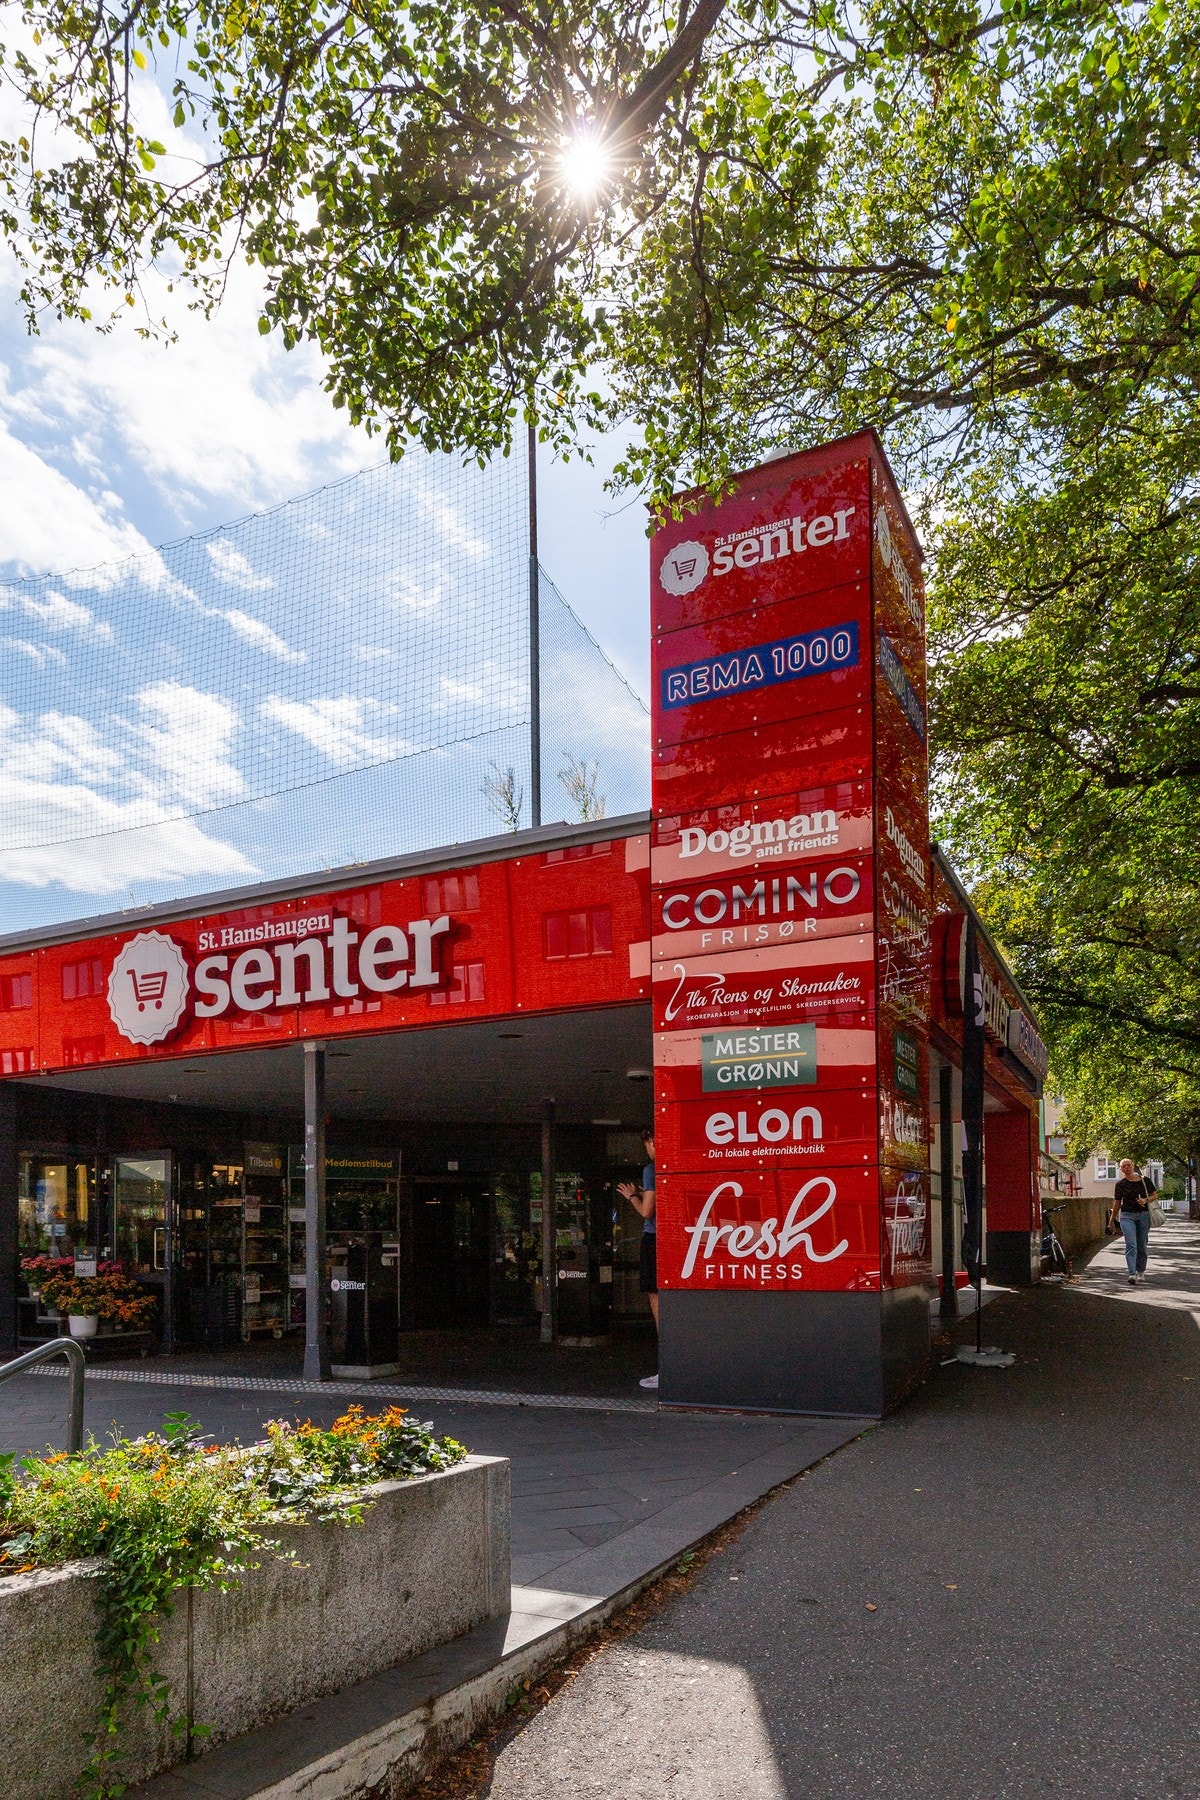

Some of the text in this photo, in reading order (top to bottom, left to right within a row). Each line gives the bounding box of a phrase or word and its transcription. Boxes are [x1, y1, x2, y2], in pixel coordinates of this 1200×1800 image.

[712, 506, 856, 577] senter
[714, 518, 791, 547] St. Hanshaugen
[668, 631, 851, 702] REMA 1000
[678, 809, 840, 858] Dogman
[756, 832, 839, 859] and friends
[886, 805, 925, 881] Dogman
[662, 867, 861, 929] COMINO
[199, 913, 331, 951] St. Hanshaugen
[701, 917, 817, 948] FRISØR
[194, 915, 450, 1018] senter
[711, 988, 750, 1006] Rens
[753, 988, 774, 1005] og
[779, 972, 861, 998] Skomaker
[686, 996, 861, 1021] SKOREPARASJON NØKKELFILING SKREDDERSERVICE
[715, 1031, 801, 1056] MESTER
[717, 1060, 799, 1083] GRØNN
[249, 1156, 274, 1168] Tilbud
[708, 1149, 723, 1158] Din
[725, 1148, 751, 1158] lokale
[752, 1144, 826, 1156] elektronikkbutikk
[681, 1176, 849, 1279] fresh
[340, 1280, 366, 1290] senter
[566, 1270, 588, 1279] senter
[705, 1264, 803, 1280] FITNESS
